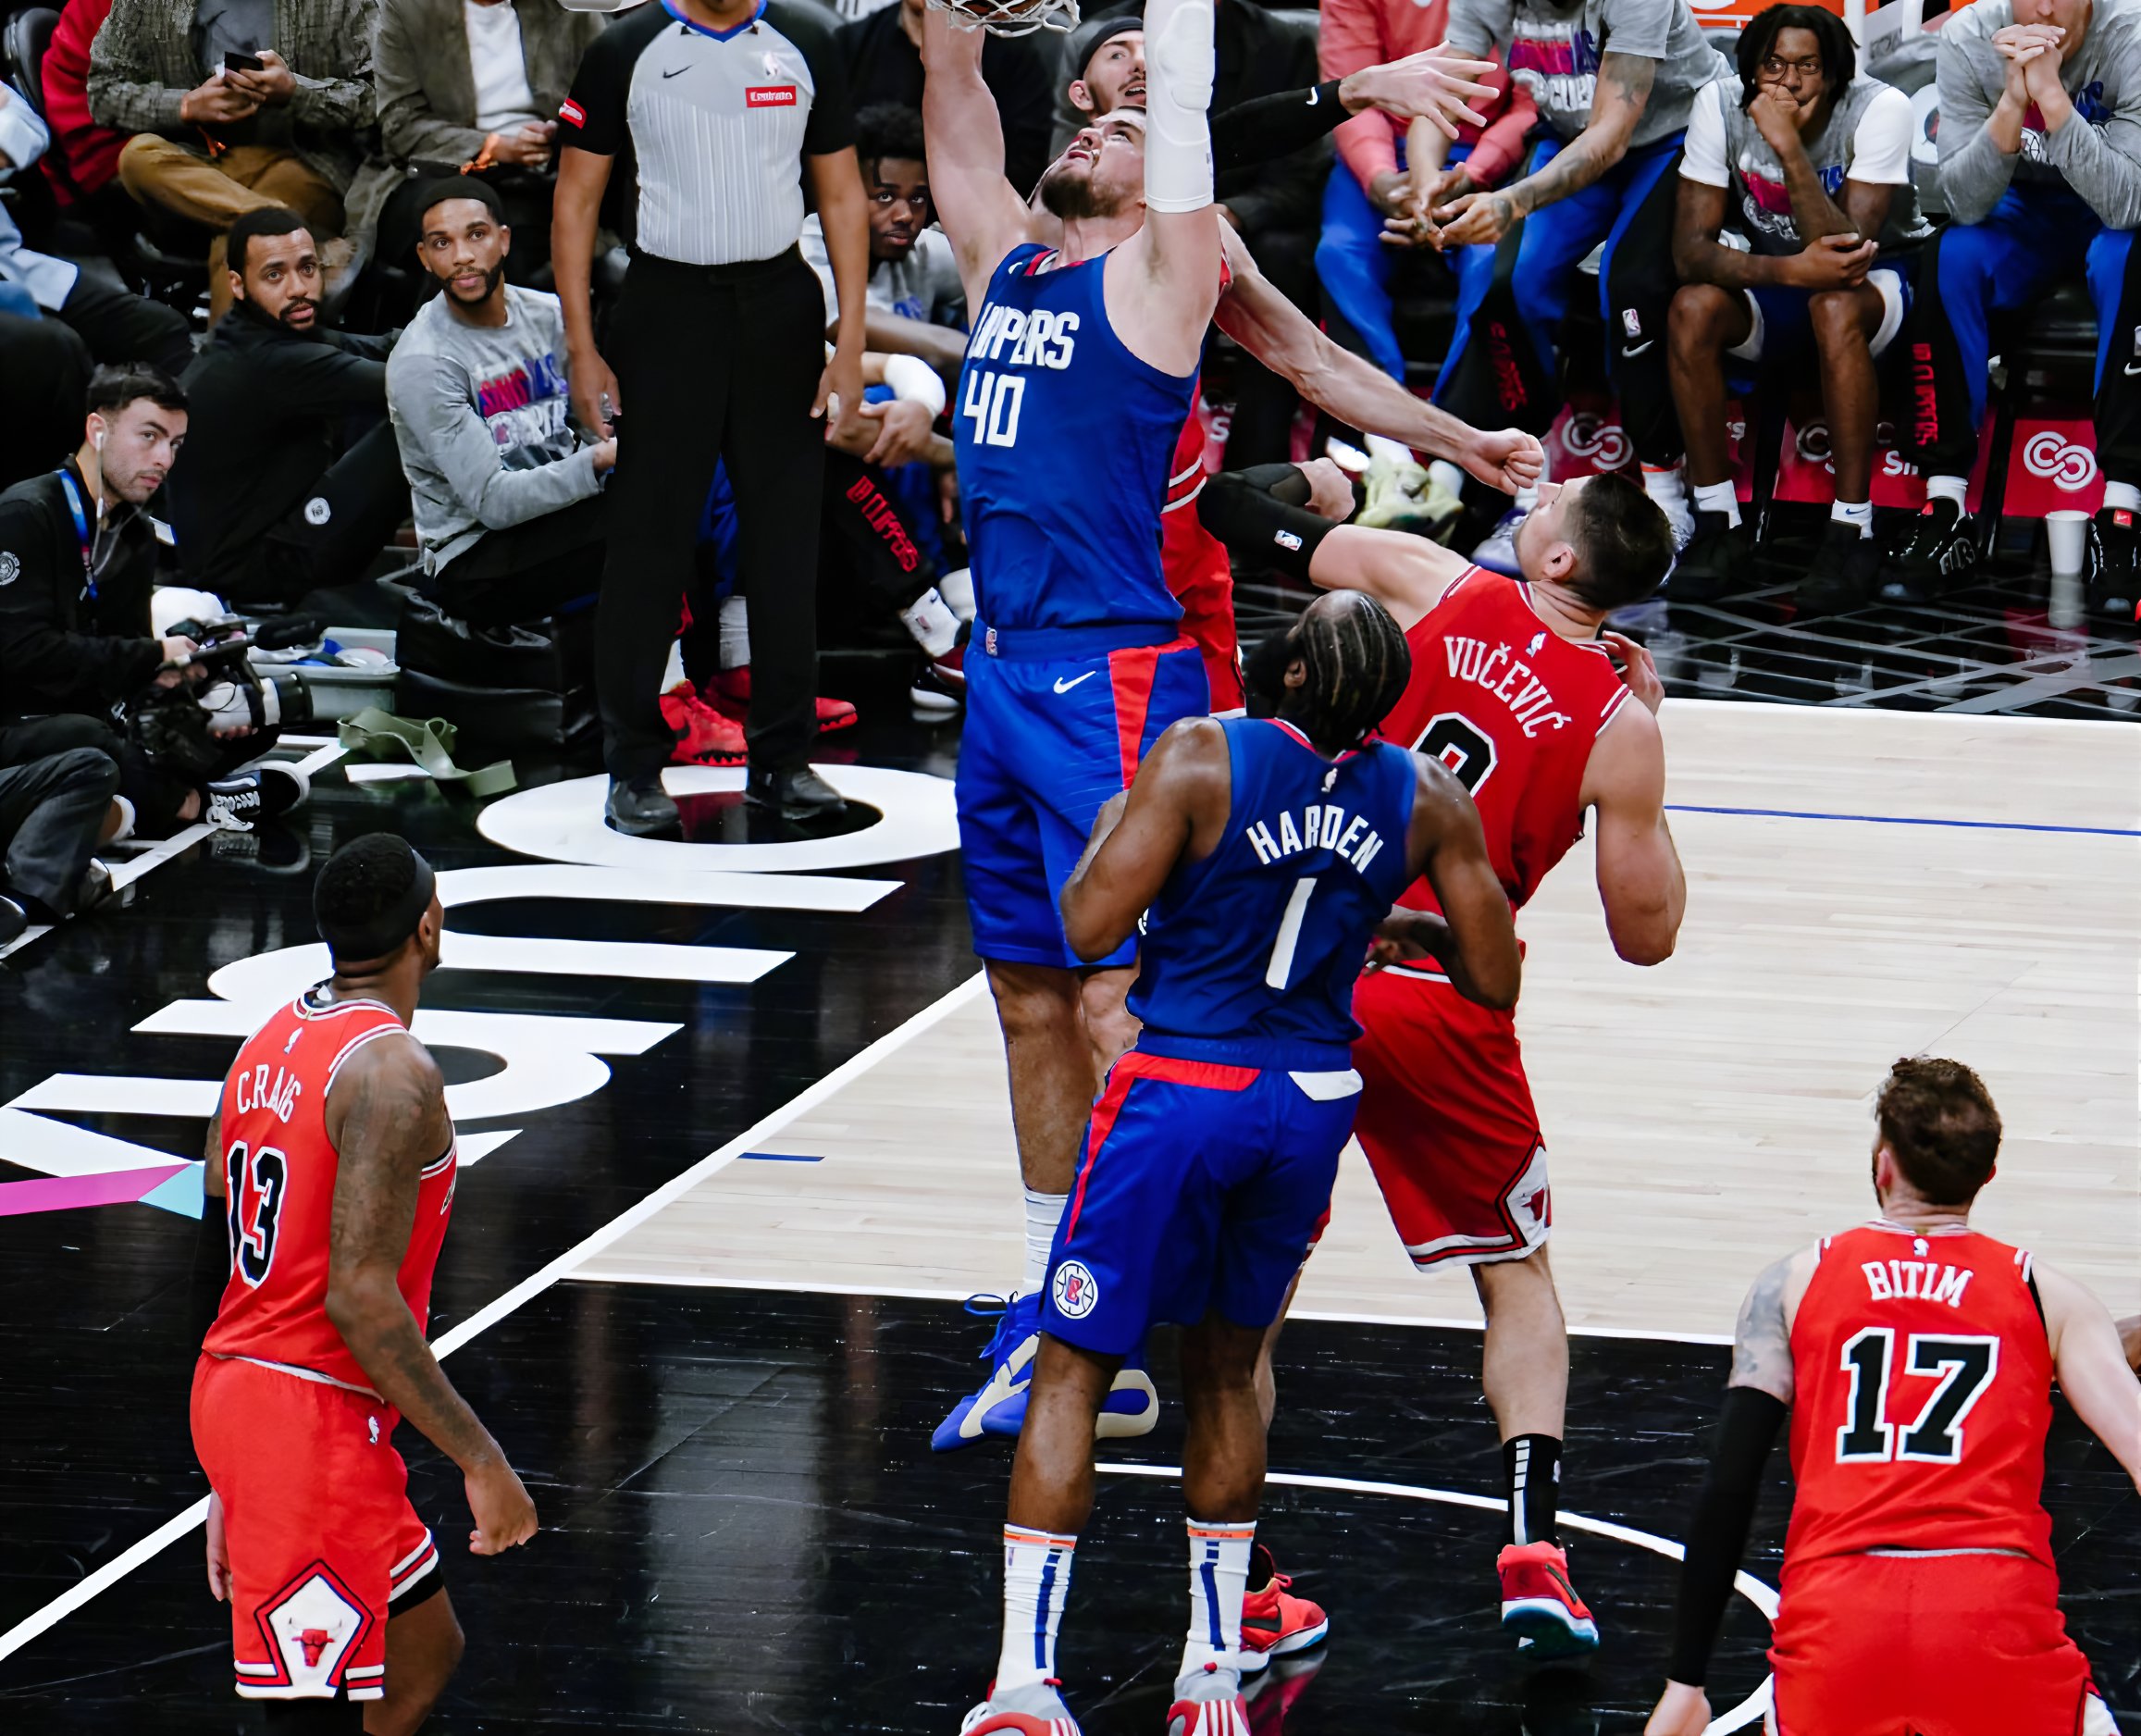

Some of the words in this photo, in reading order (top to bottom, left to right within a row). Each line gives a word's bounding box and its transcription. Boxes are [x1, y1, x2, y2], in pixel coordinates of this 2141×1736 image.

[963, 369, 1025, 448] 40
[1443, 636, 1572, 738] VUČEVIĆ
[1245, 804, 1384, 874] HARDEN
[1265, 877, 1318, 990] 1
[237, 1062, 302, 1123] CRAIG
[226, 1139, 288, 1291] 13
[1861, 1259, 1974, 1308] BITIM
[1836, 1326, 2000, 1465] 17
